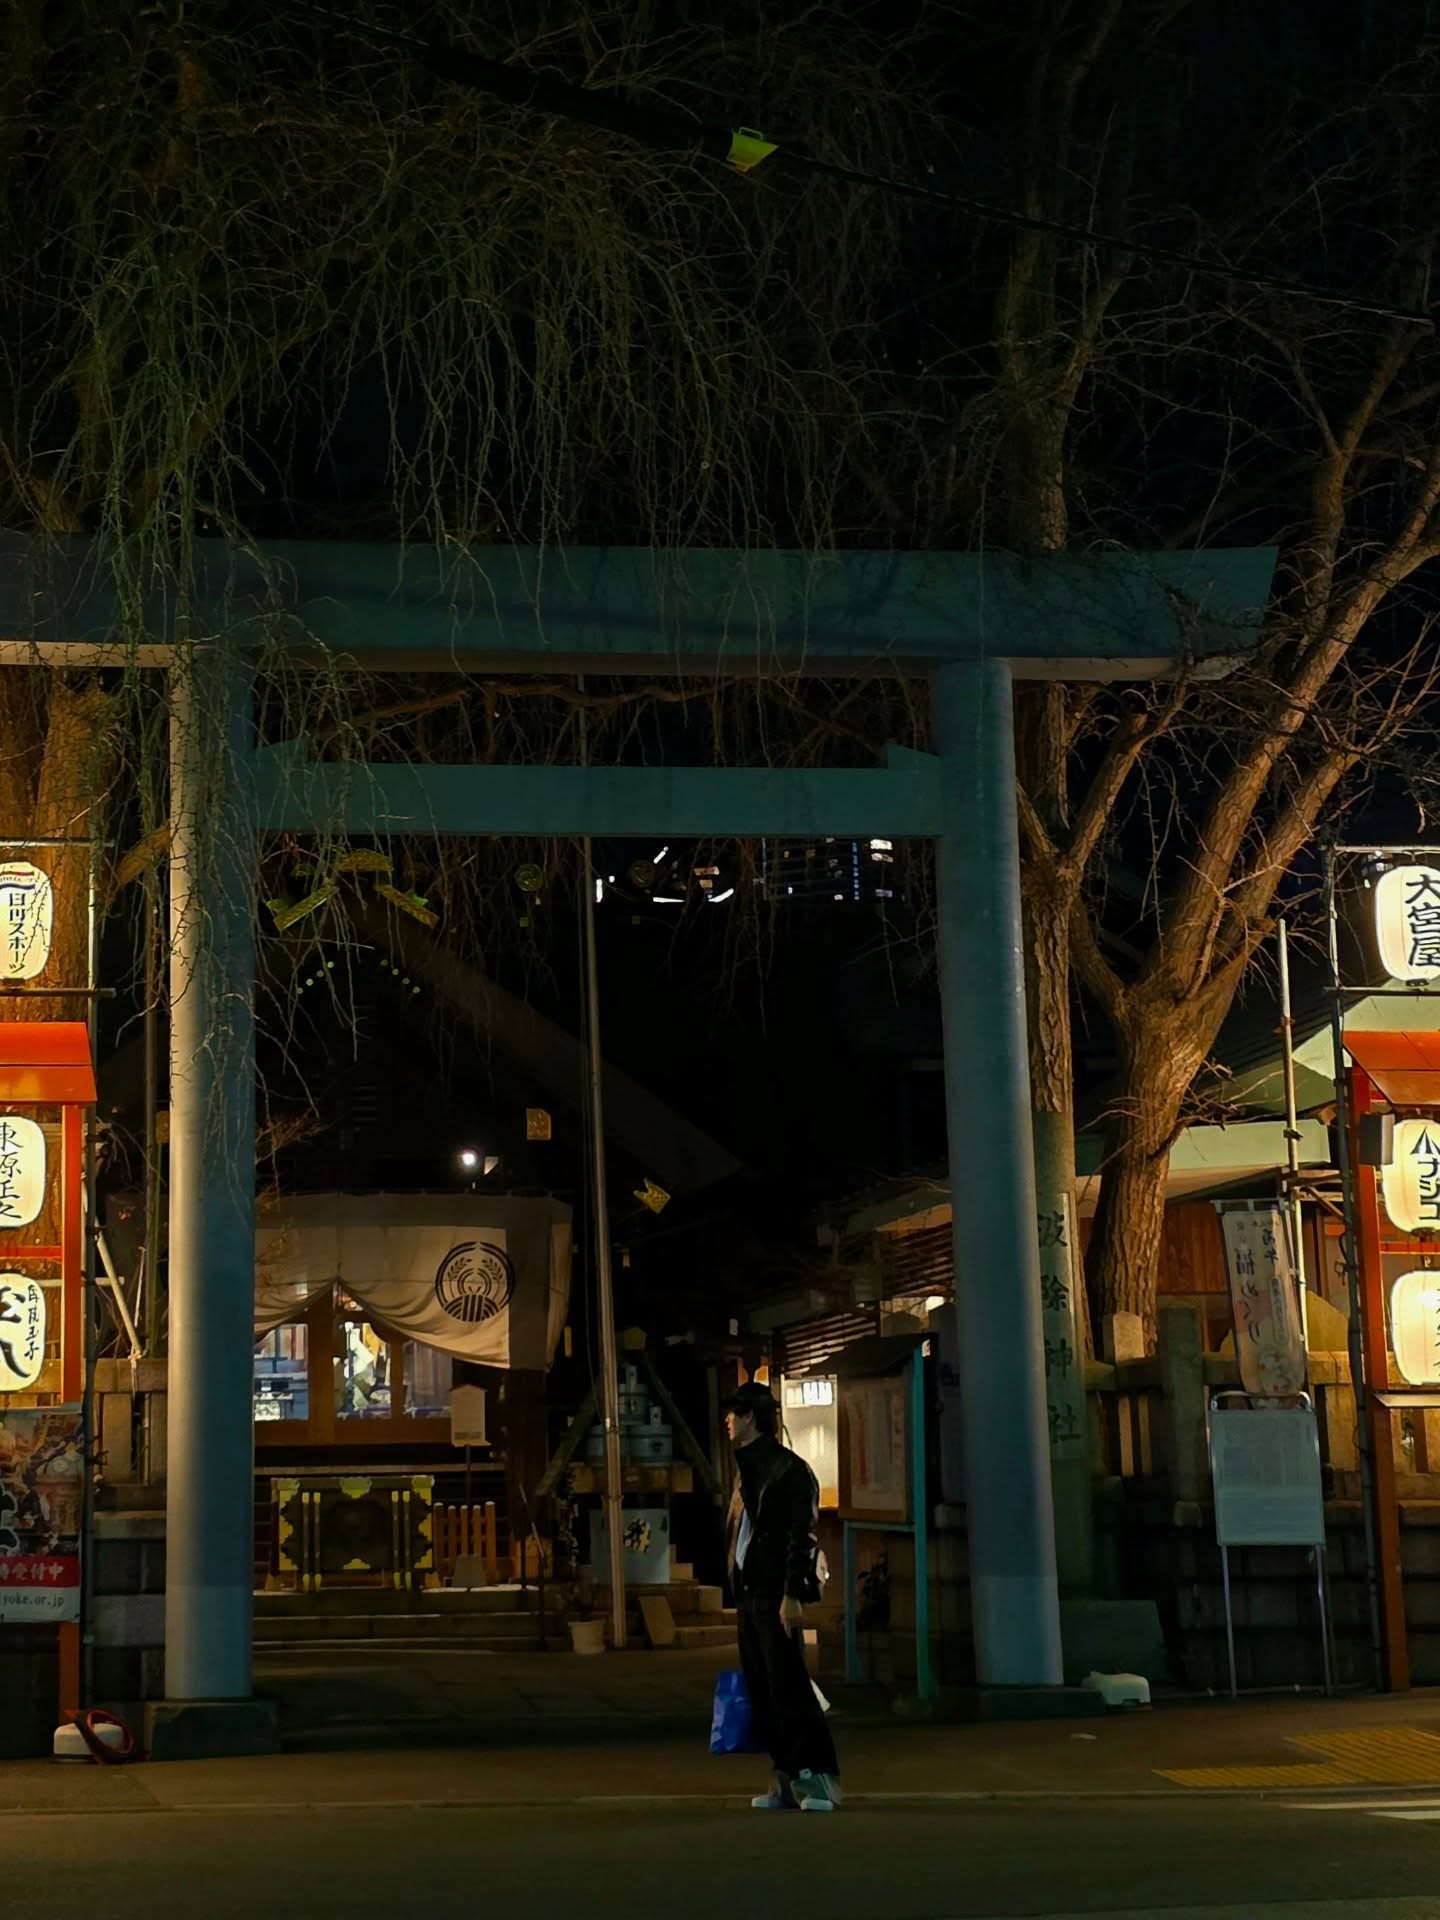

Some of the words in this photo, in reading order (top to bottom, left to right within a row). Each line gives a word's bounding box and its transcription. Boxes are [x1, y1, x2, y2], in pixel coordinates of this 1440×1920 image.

[1405, 874, 1440, 967] 大宮屋
[1037, 1210, 1082, 1445] 波除神社
